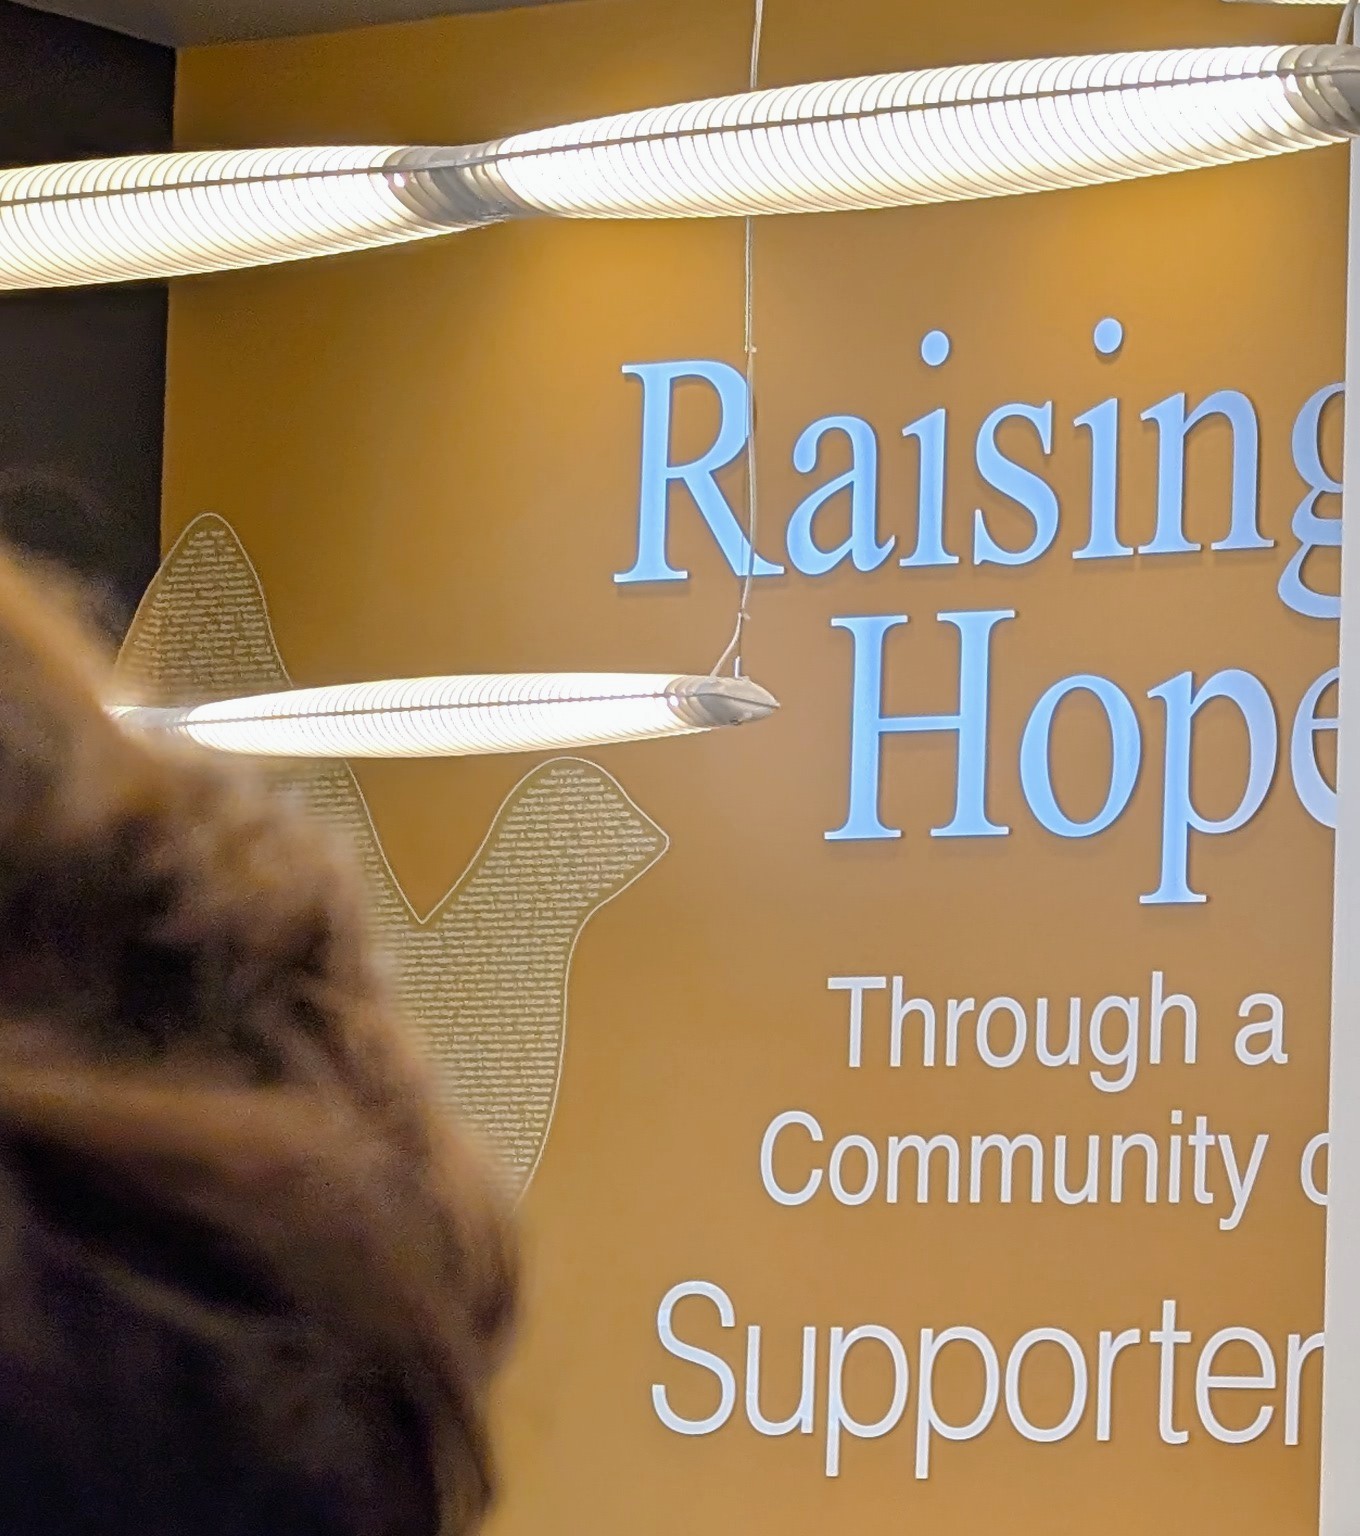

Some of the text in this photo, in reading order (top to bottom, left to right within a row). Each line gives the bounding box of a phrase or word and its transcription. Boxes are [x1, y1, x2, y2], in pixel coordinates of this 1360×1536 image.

[614, 318, 1345, 618] Raising
[827, 970, 1288, 1093] Through a
[760, 1110, 1269, 1231] Community
